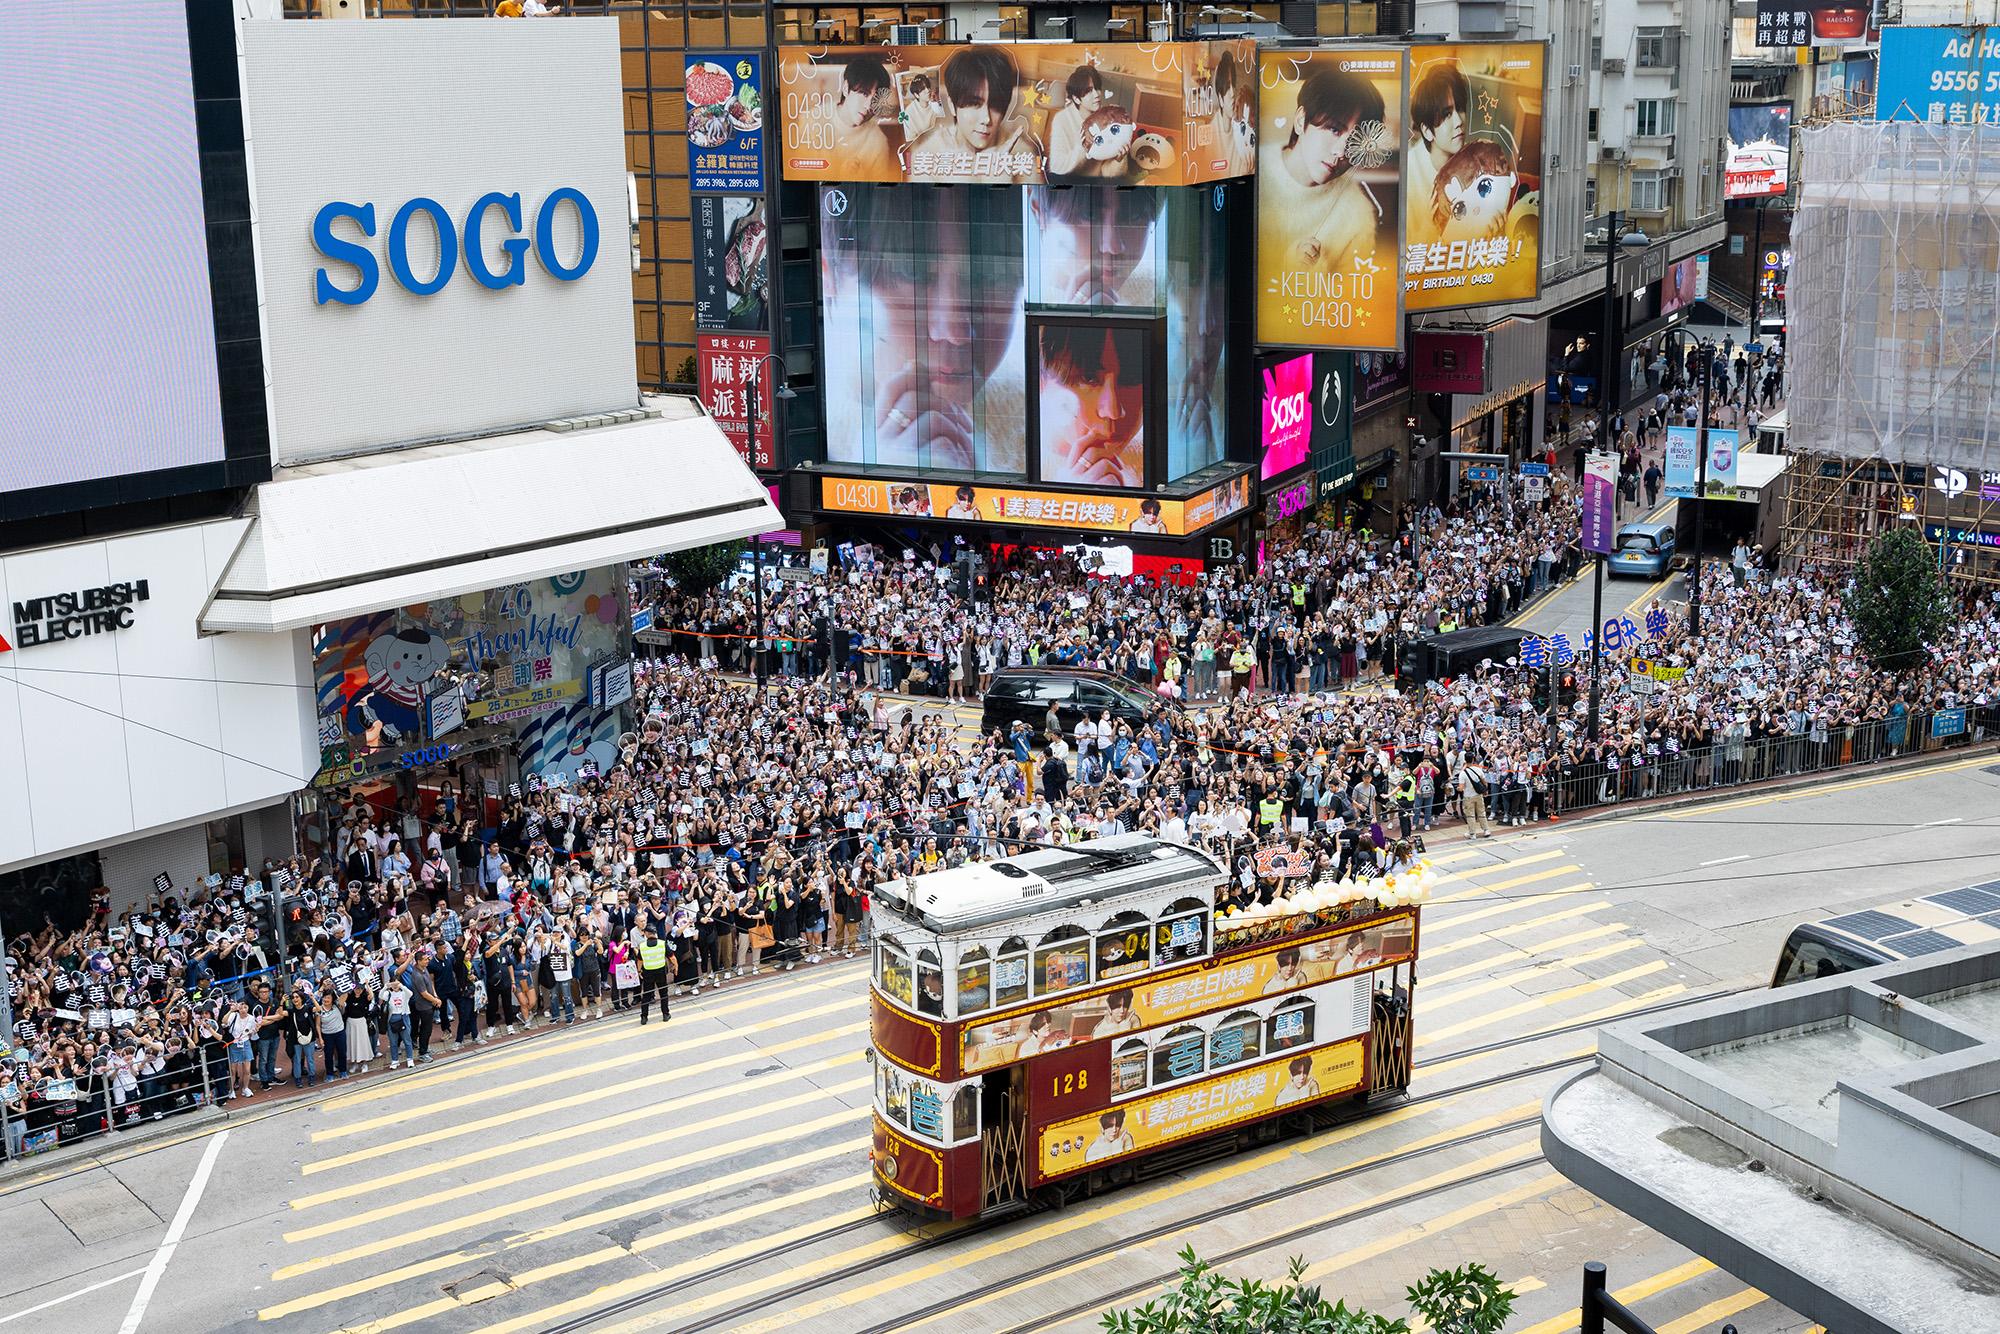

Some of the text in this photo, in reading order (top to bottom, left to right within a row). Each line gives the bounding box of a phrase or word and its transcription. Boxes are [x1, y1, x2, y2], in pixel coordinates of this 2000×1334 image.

[1759, 11, 1807, 27] 敢挑戰
[1758, 30, 1806, 45] 再超越
[1942, 39, 1972, 58] Ad
[1930, 70, 1979, 91] 9556
[787, 92, 834, 120] 0430
[739, 137, 758, 150] 6/F
[788, 122, 834, 150] 0430
[312, 187, 600, 306] SOGO
[1281, 271, 1373, 300] KEUNG TO
[1422, 275, 1467, 290] BIRTHDAY
[1470, 273, 1494, 286] 0430
[698, 301, 711, 312] 3F
[1301, 300, 1352, 328] 0430
[711, 354, 761, 386] 麻辣
[836, 483, 878, 509] 0430
[13, 579, 150, 624] MITSUBISHI
[15, 606, 135, 649] ELECTRIC
[454, 613, 584, 673] Thankful
[494, 657, 553, 690] 感謝祭
[401, 743, 450, 770] SOGO
[1163, 1005, 1186, 1017] HAPPY
[1053, 1069, 1089, 1097] 128
[1161, 1121, 1187, 1136] HAPPY
[1191, 1110, 1230, 1127] BIRTHDAY
[885, 1135, 900, 1156] 128
